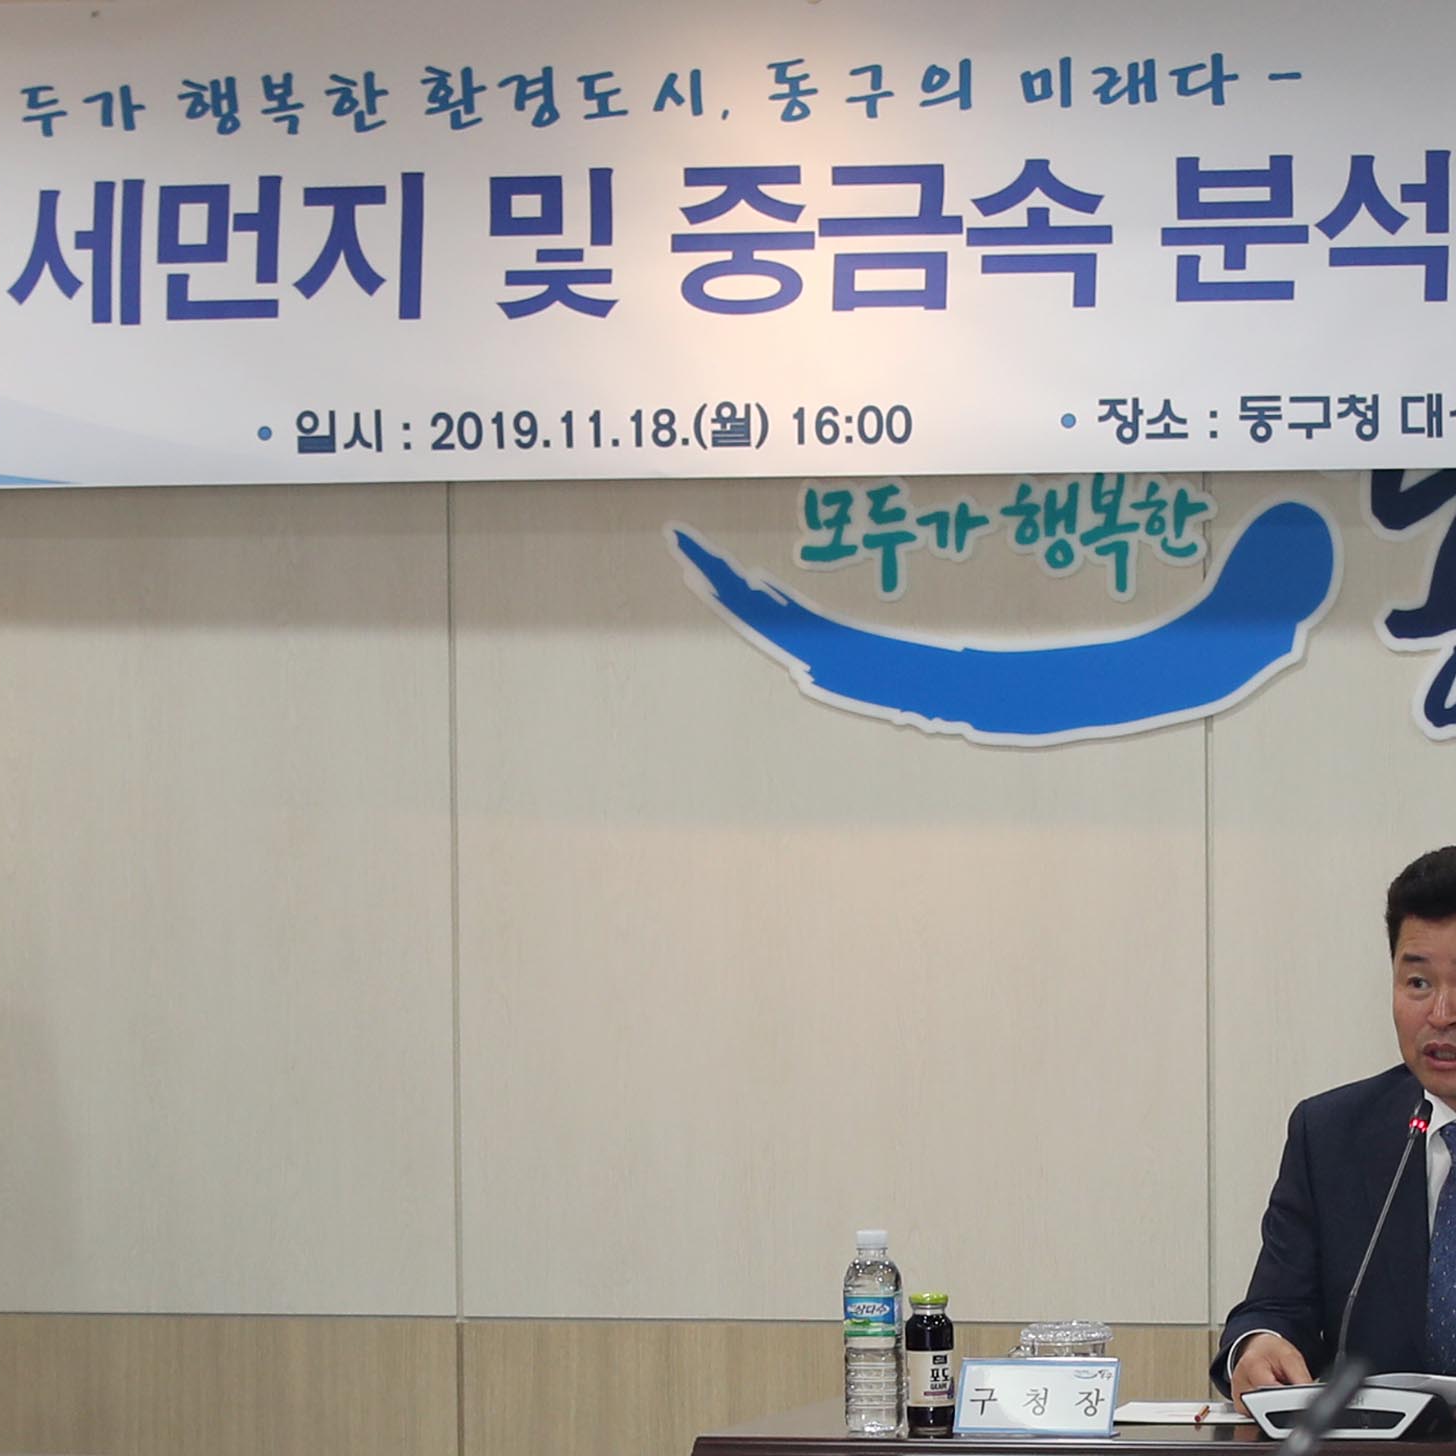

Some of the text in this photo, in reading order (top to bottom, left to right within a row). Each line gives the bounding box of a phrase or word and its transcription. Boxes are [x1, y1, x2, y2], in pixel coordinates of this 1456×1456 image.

[177, 70, 391, 137] 행복한
[418, 63, 730, 132] 환경도시,
[765, 56, 974, 123] 동구의
[1019, 51, 1241, 109] 미래다
[487, 166, 619, 321] 및
[669, 157, 1115, 316] 중금속
[295, 408, 384, 455] 일시
[429, 400, 770, 452] 2019.11.18.(월)
[791, 403, 914, 447] 16:00
[1096, 396, 1190, 446] 장소
[1237, 392, 1381, 445] 동구청
[799, 484, 990, 594] 모두가
[999, 471, 1211, 594] 행복한
